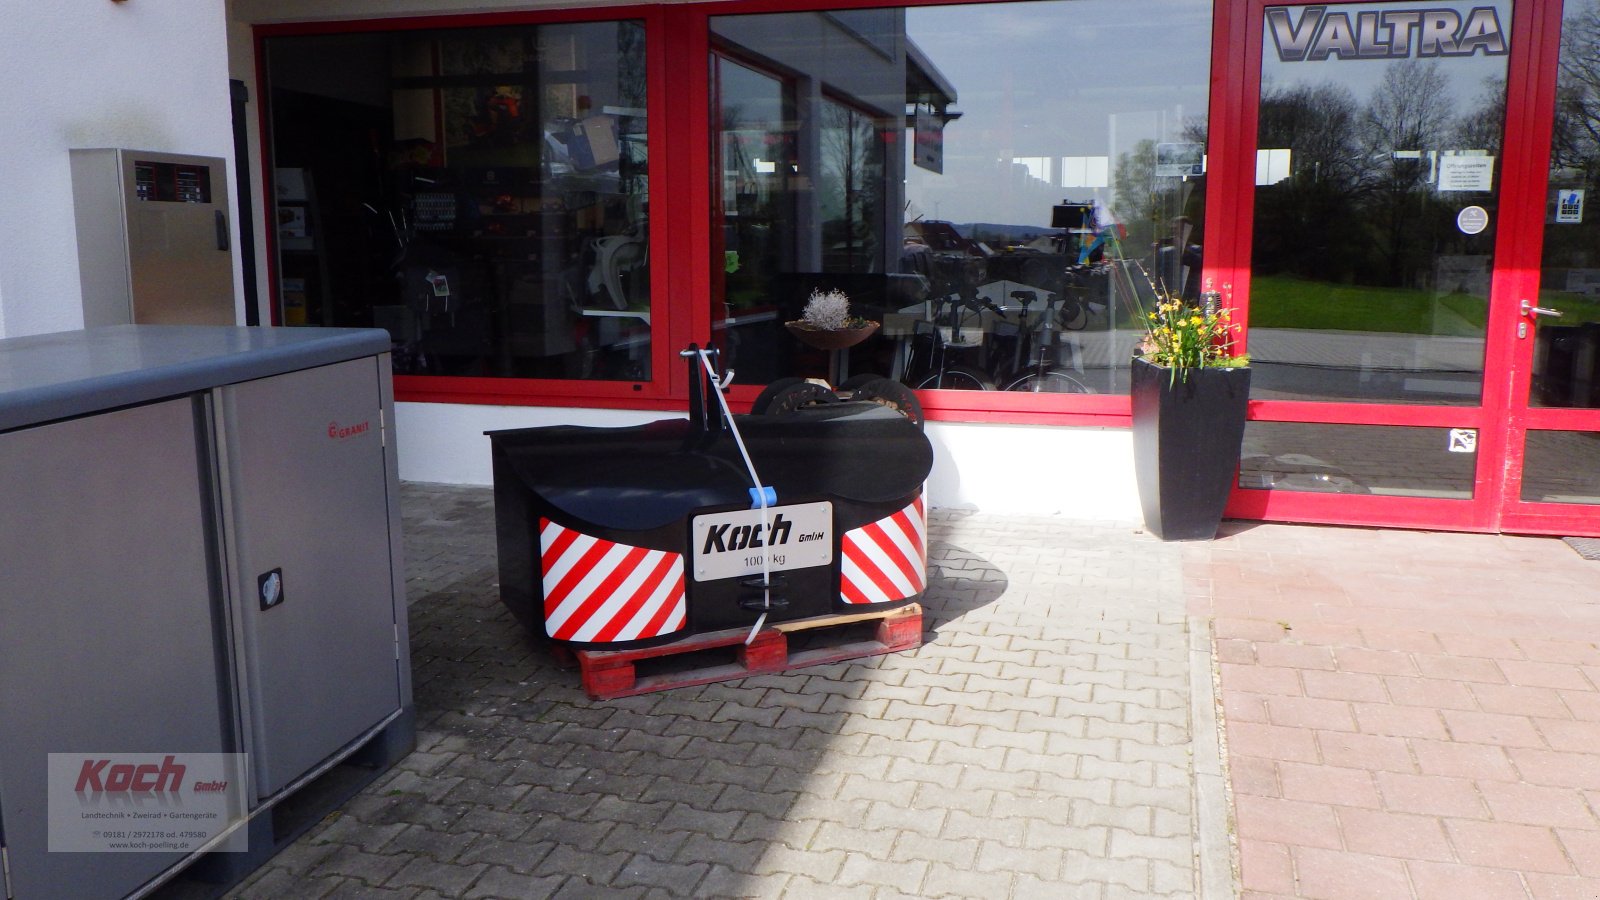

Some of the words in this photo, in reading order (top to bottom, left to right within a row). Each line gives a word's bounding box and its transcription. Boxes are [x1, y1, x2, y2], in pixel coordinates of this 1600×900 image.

[1264, 6, 1509, 62] VALTRA
[702, 514, 792, 554] Koch
[744, 555, 770, 566] 100
[773, 554, 786, 565] kg
